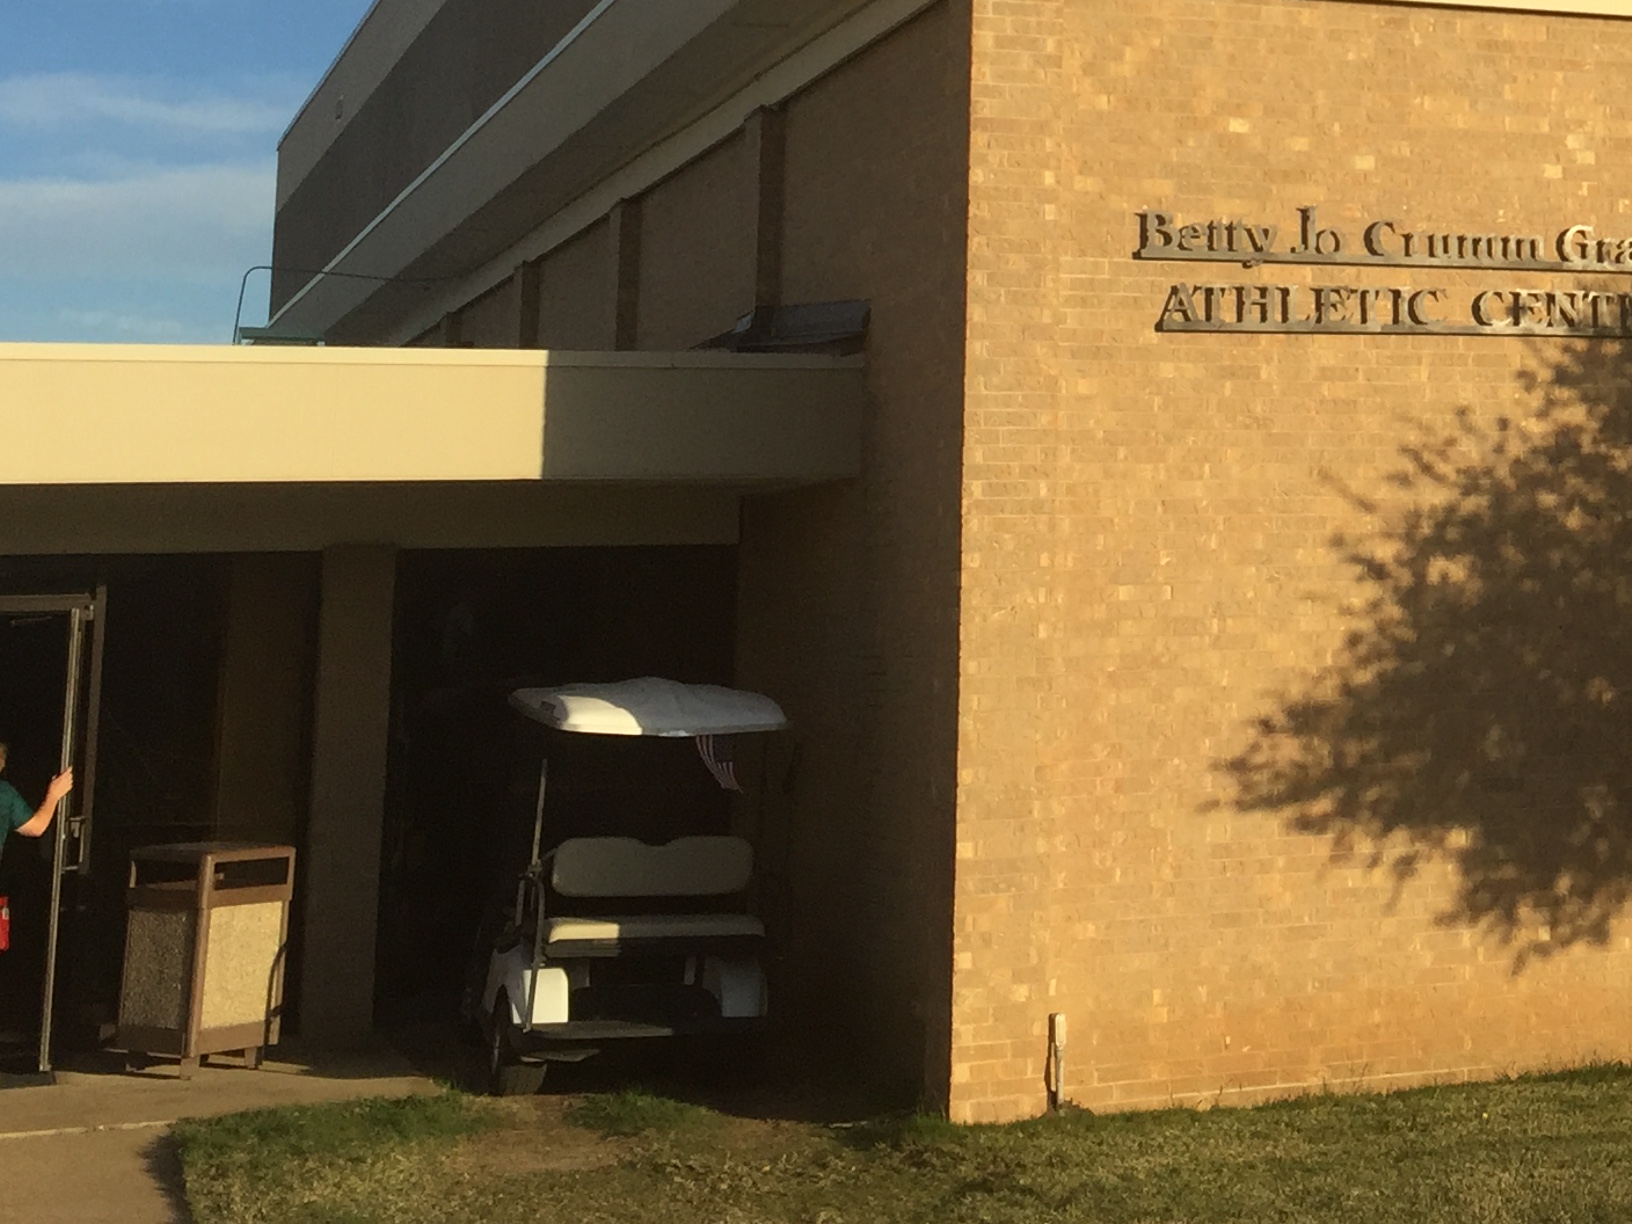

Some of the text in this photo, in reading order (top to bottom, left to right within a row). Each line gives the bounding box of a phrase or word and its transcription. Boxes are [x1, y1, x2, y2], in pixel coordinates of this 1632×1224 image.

[1137, 208, 1278, 267] Betty
[1293, 206, 1343, 256] Jo
[1162, 282, 1448, 325] ATHLETIC
